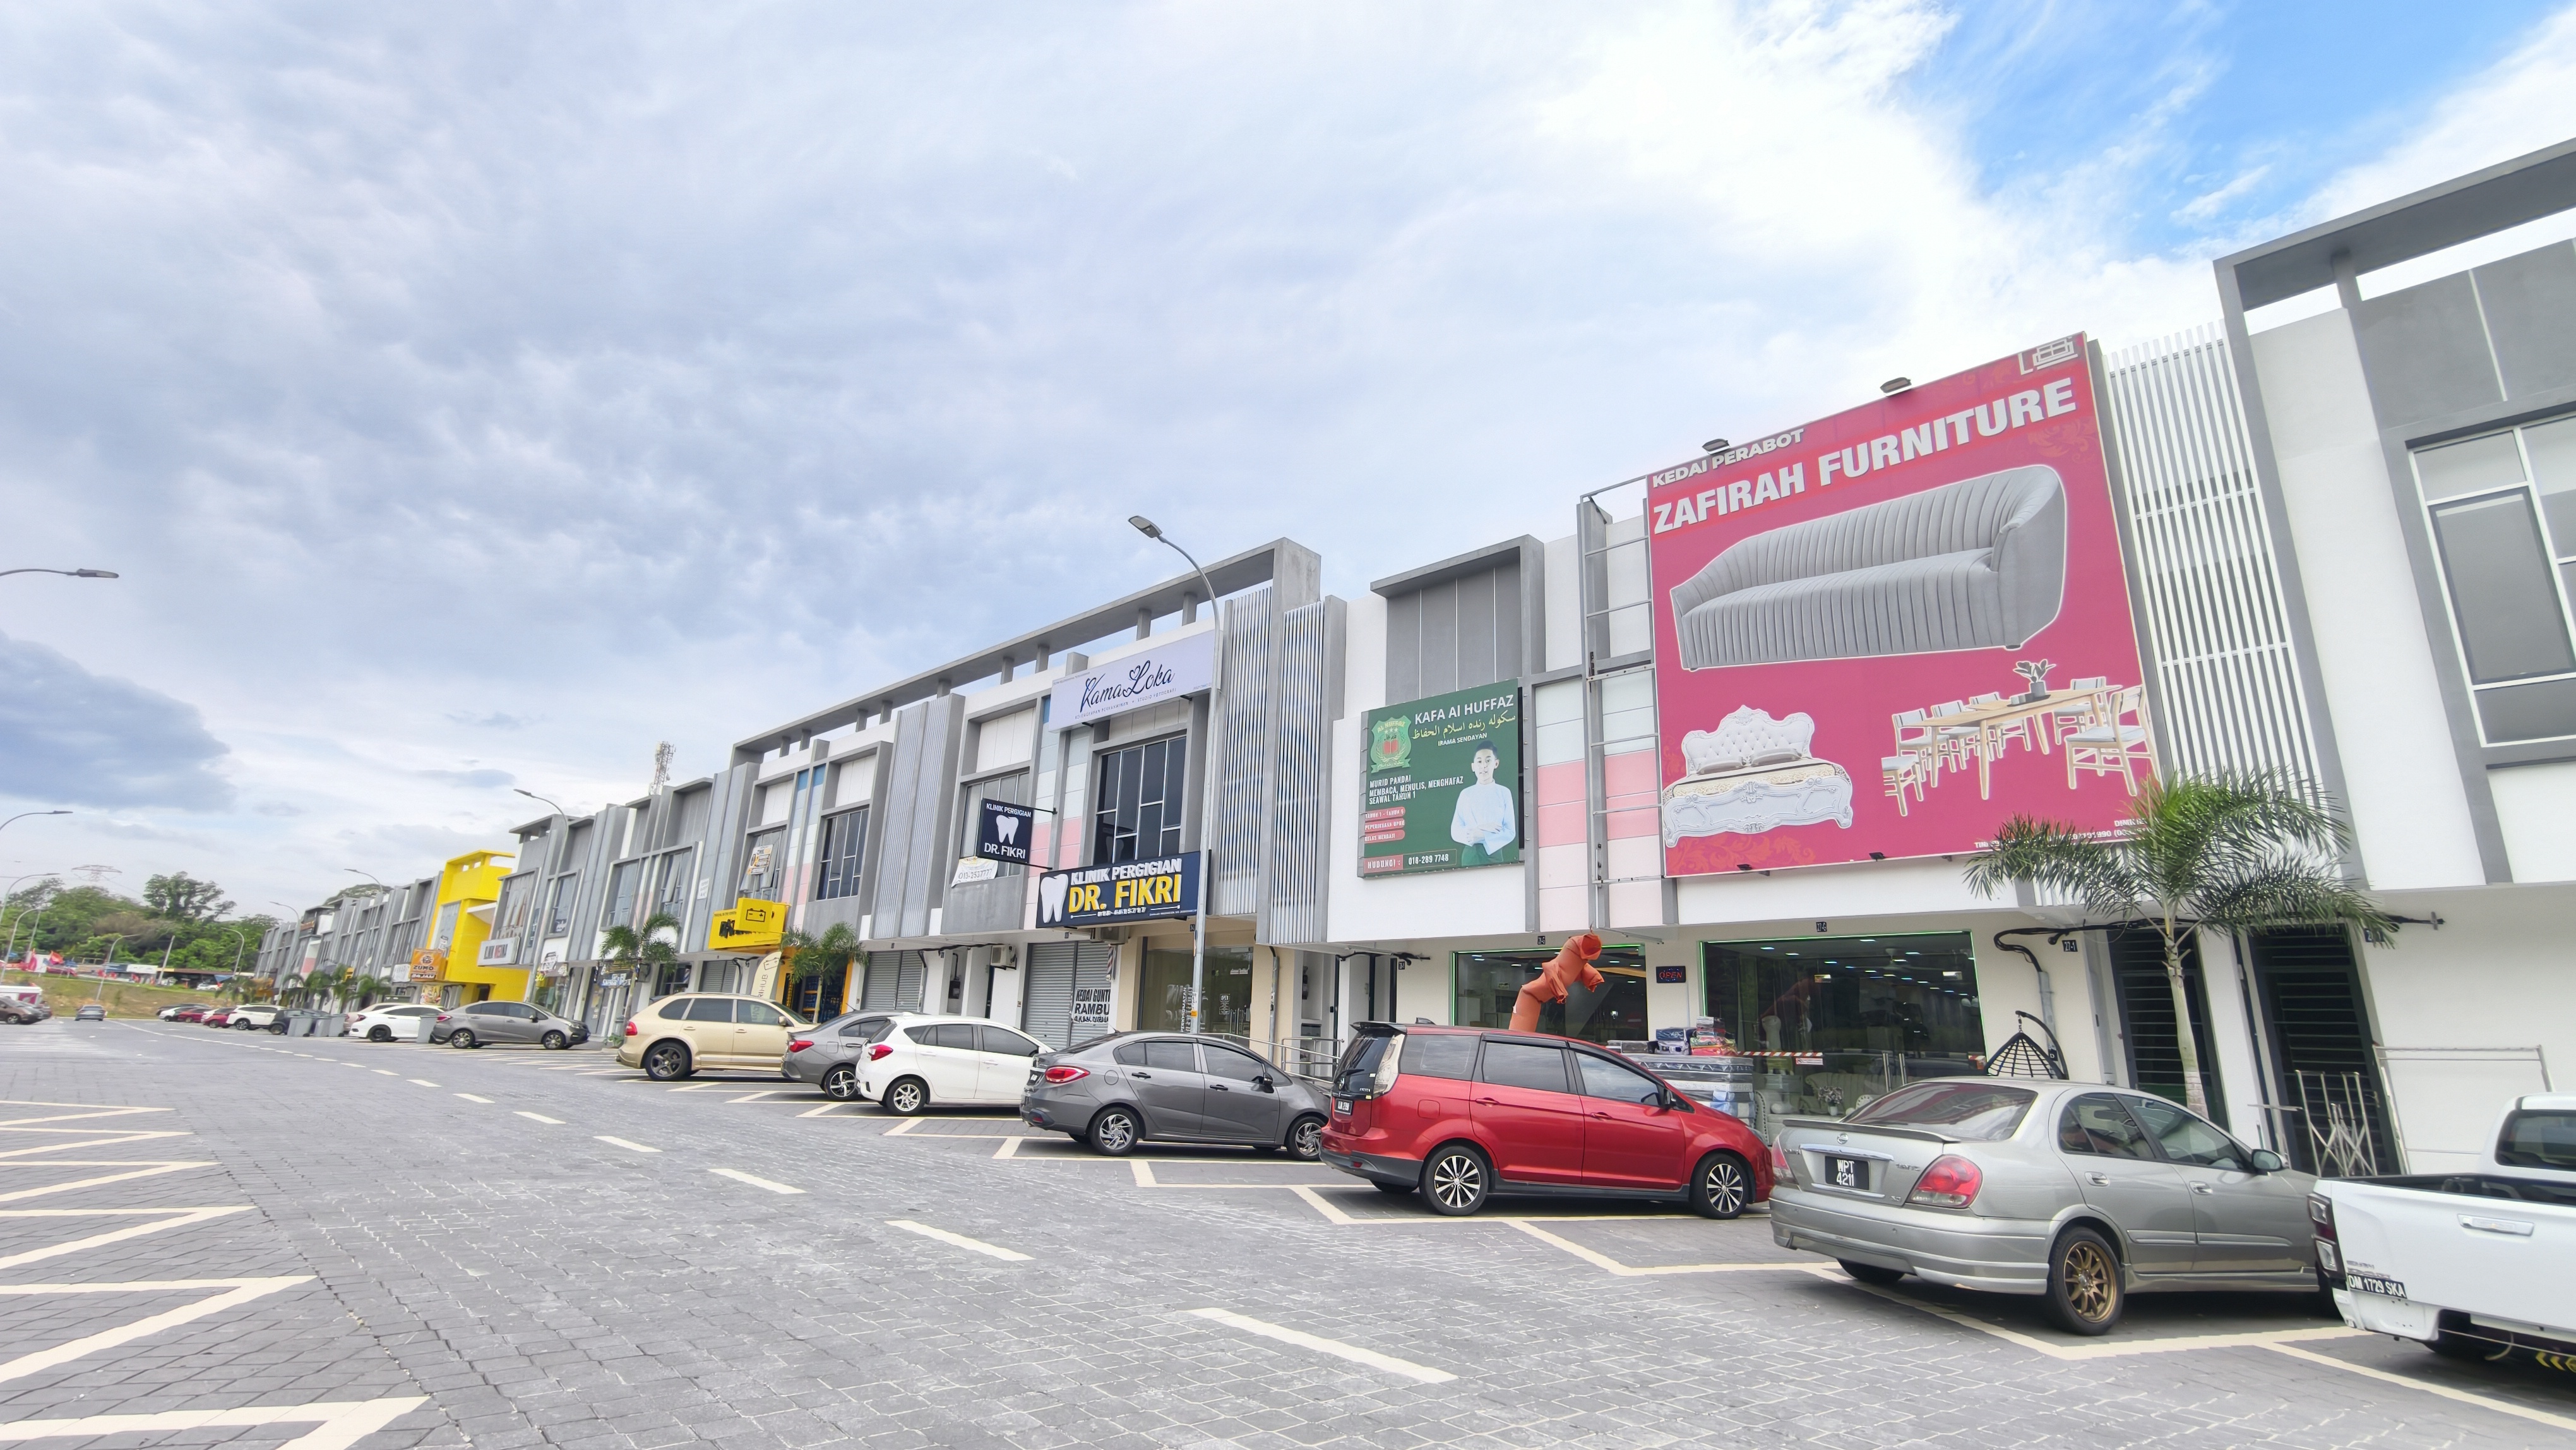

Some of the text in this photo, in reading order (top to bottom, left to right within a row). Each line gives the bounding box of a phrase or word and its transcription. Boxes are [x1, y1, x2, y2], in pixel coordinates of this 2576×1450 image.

[1653, 428, 1804, 488] KEDAI PERABOT
[1654, 377, 2077, 534] ZAFIRAH FURNITURE
[1080, 660, 1176, 713] Kama Loka
[1415, 709, 1445, 724] KAFA
[1465, 695, 1513, 716] HUFFAZ
[1438, 733, 1488, 746] IRAMA SENDAYAN
[1369, 775, 1411, 788] MURID PANDAI
[1369, 776, 1464, 798] MEMBACA, MENULIS, MENGHAFAZ
[1369, 795, 1390, 805] SEAWAL
[1392, 791, 1411, 802] TAHUN
[986, 803, 1003, 812] KLINIK
[984, 842, 1026, 859] DR. FIKRI
[1434, 854, 1449, 863] 7748
[1071, 858, 1183, 885] KLINIK PERGIGIAN
[1068, 874, 1182, 913] DR. FIKRI
[1659, 971, 1683, 980] OPEN
[1075, 989, 1092, 1002] KEDAI
[1837, 1159, 1854, 1173] WPT
[1836, 1172, 1854, 1187] 4211
[2364, 1277, 2385, 1293] 1729
[2385, 1281, 2406, 1298] SKA
